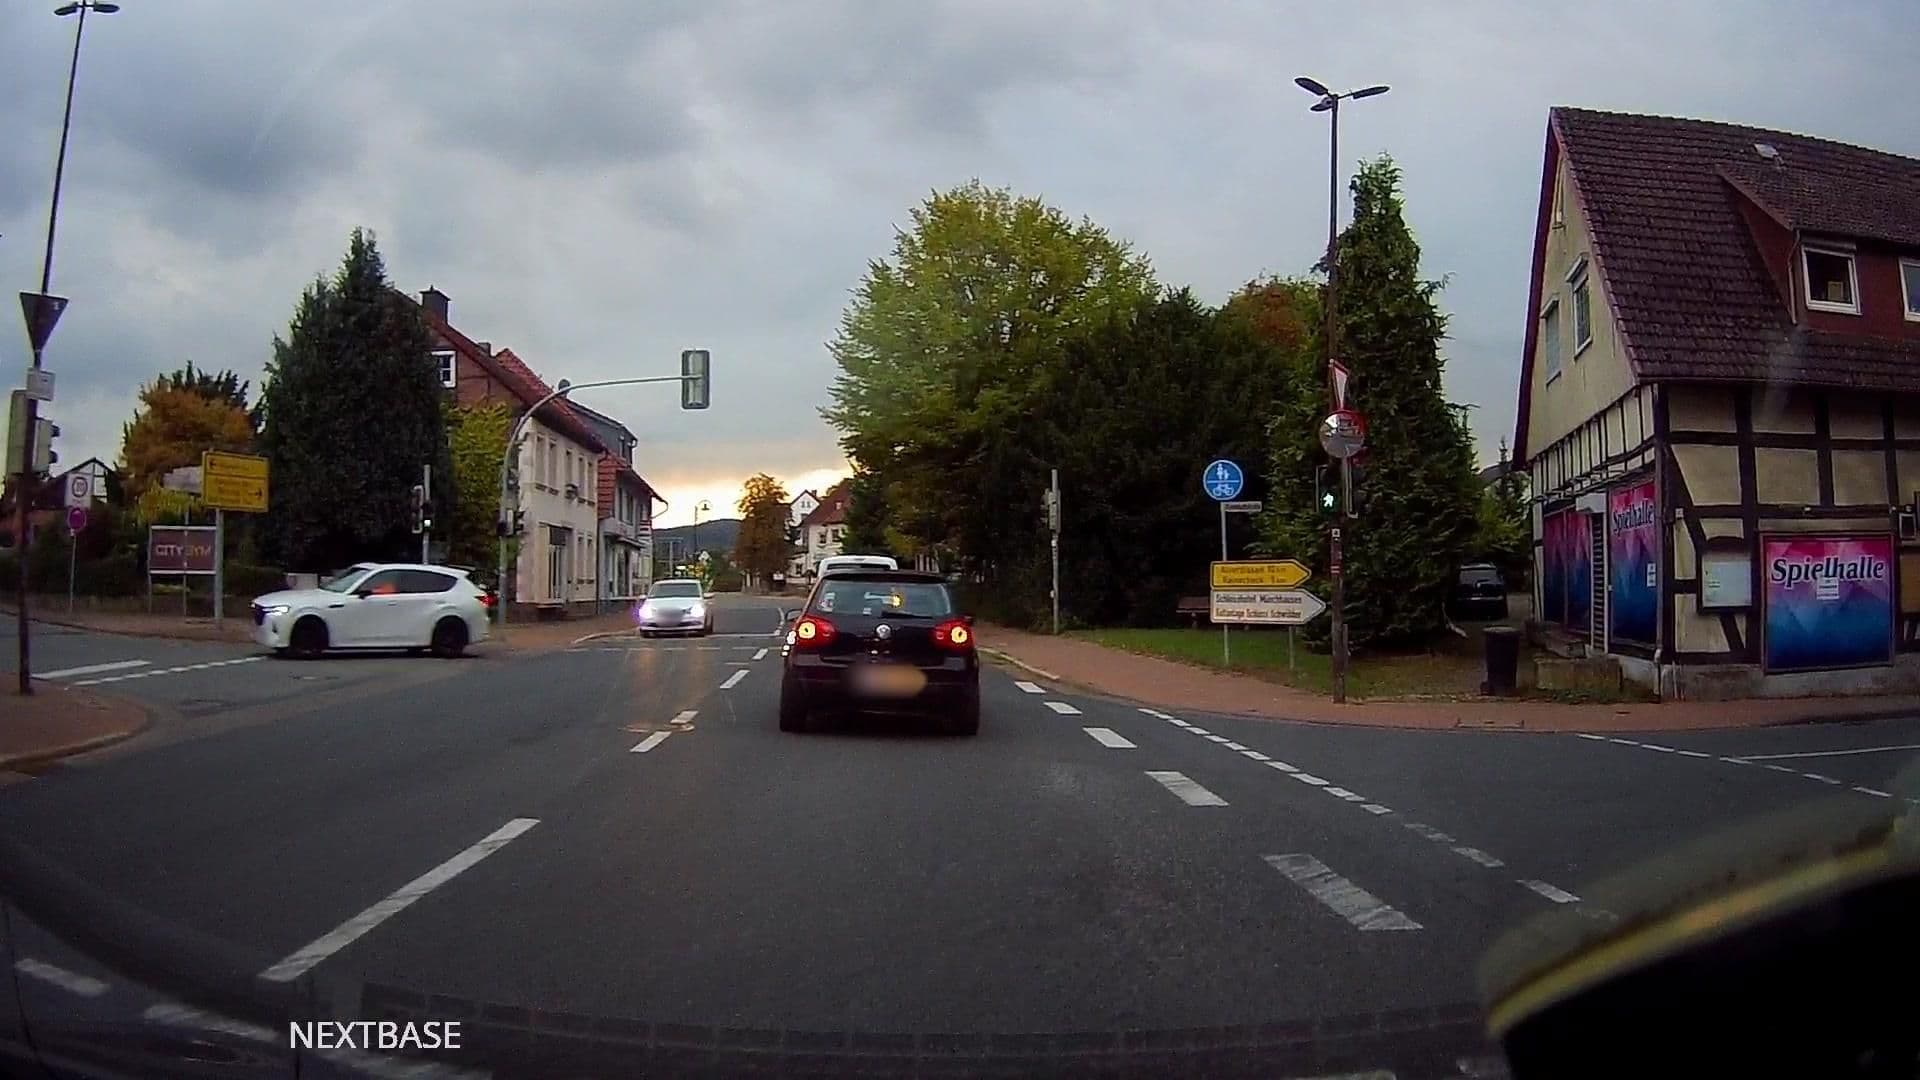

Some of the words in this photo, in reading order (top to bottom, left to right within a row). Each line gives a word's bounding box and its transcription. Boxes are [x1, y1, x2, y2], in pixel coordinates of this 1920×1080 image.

[1613, 499, 1655, 537] Spielhalle
[156, 544, 184, 557] CITY
[1770, 556, 1884, 589] Spielhalle
